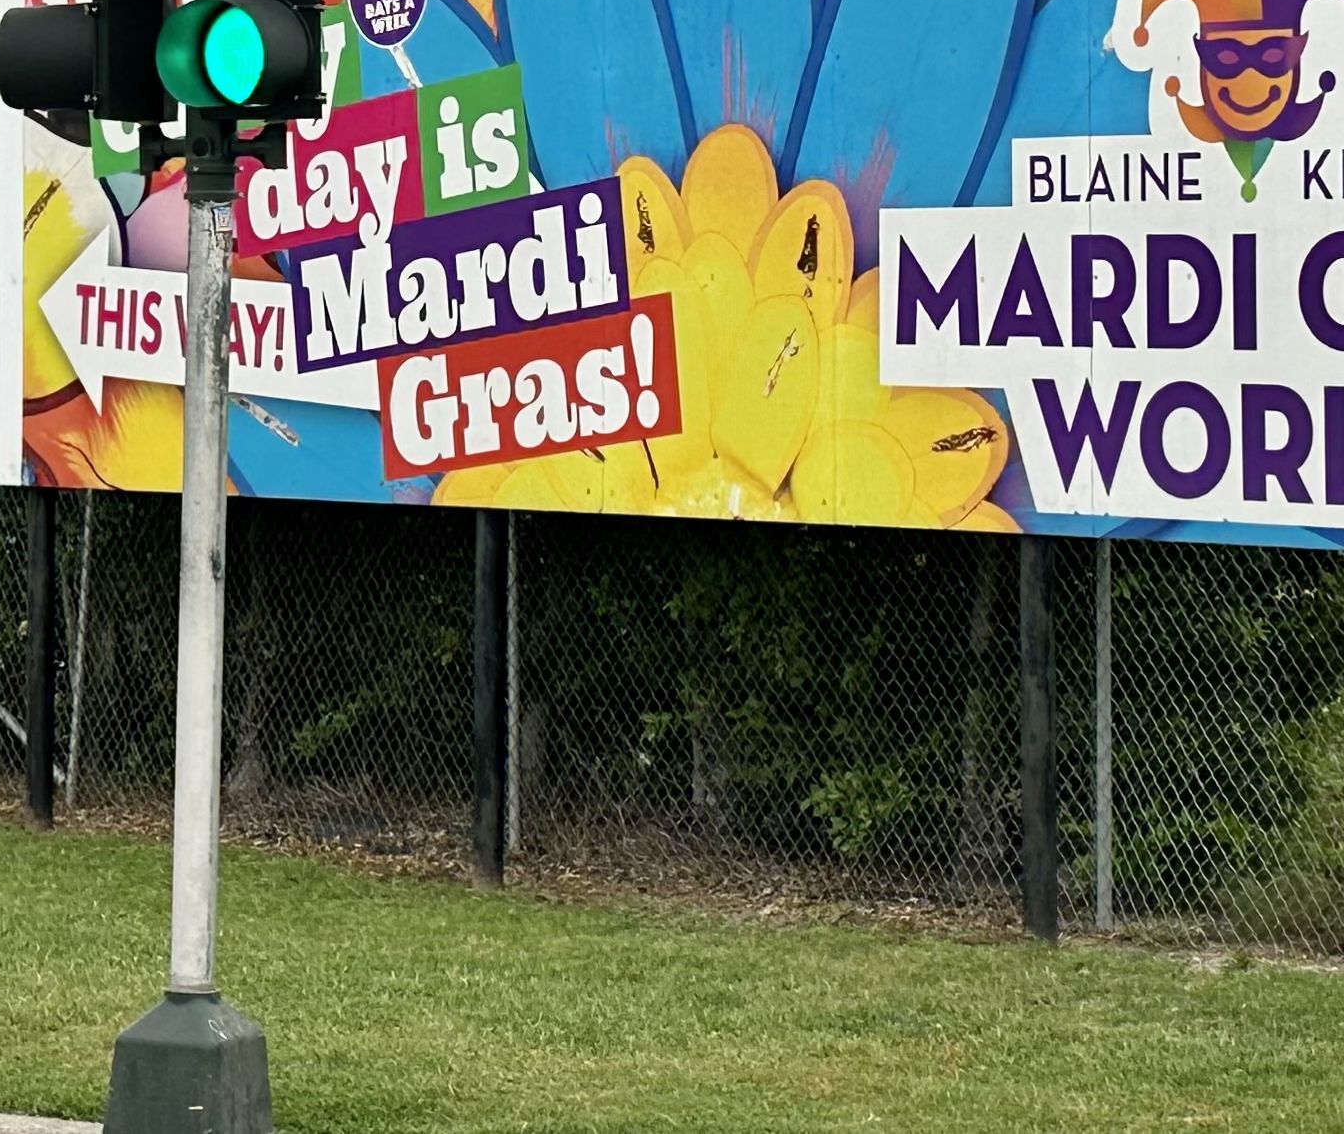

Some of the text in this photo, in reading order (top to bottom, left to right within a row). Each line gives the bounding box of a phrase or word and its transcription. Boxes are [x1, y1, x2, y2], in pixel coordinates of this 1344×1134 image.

[371, 12, 410, 34] WEEK
[248, 96, 520, 247] day is
[1029, 152, 1202, 203] BLAINE
[76, 284, 285, 372] THIS AY!
[301, 193, 618, 361] Mardi
[896, 232, 1256, 350] MARDI
[389, 313, 660, 465] Gras!
